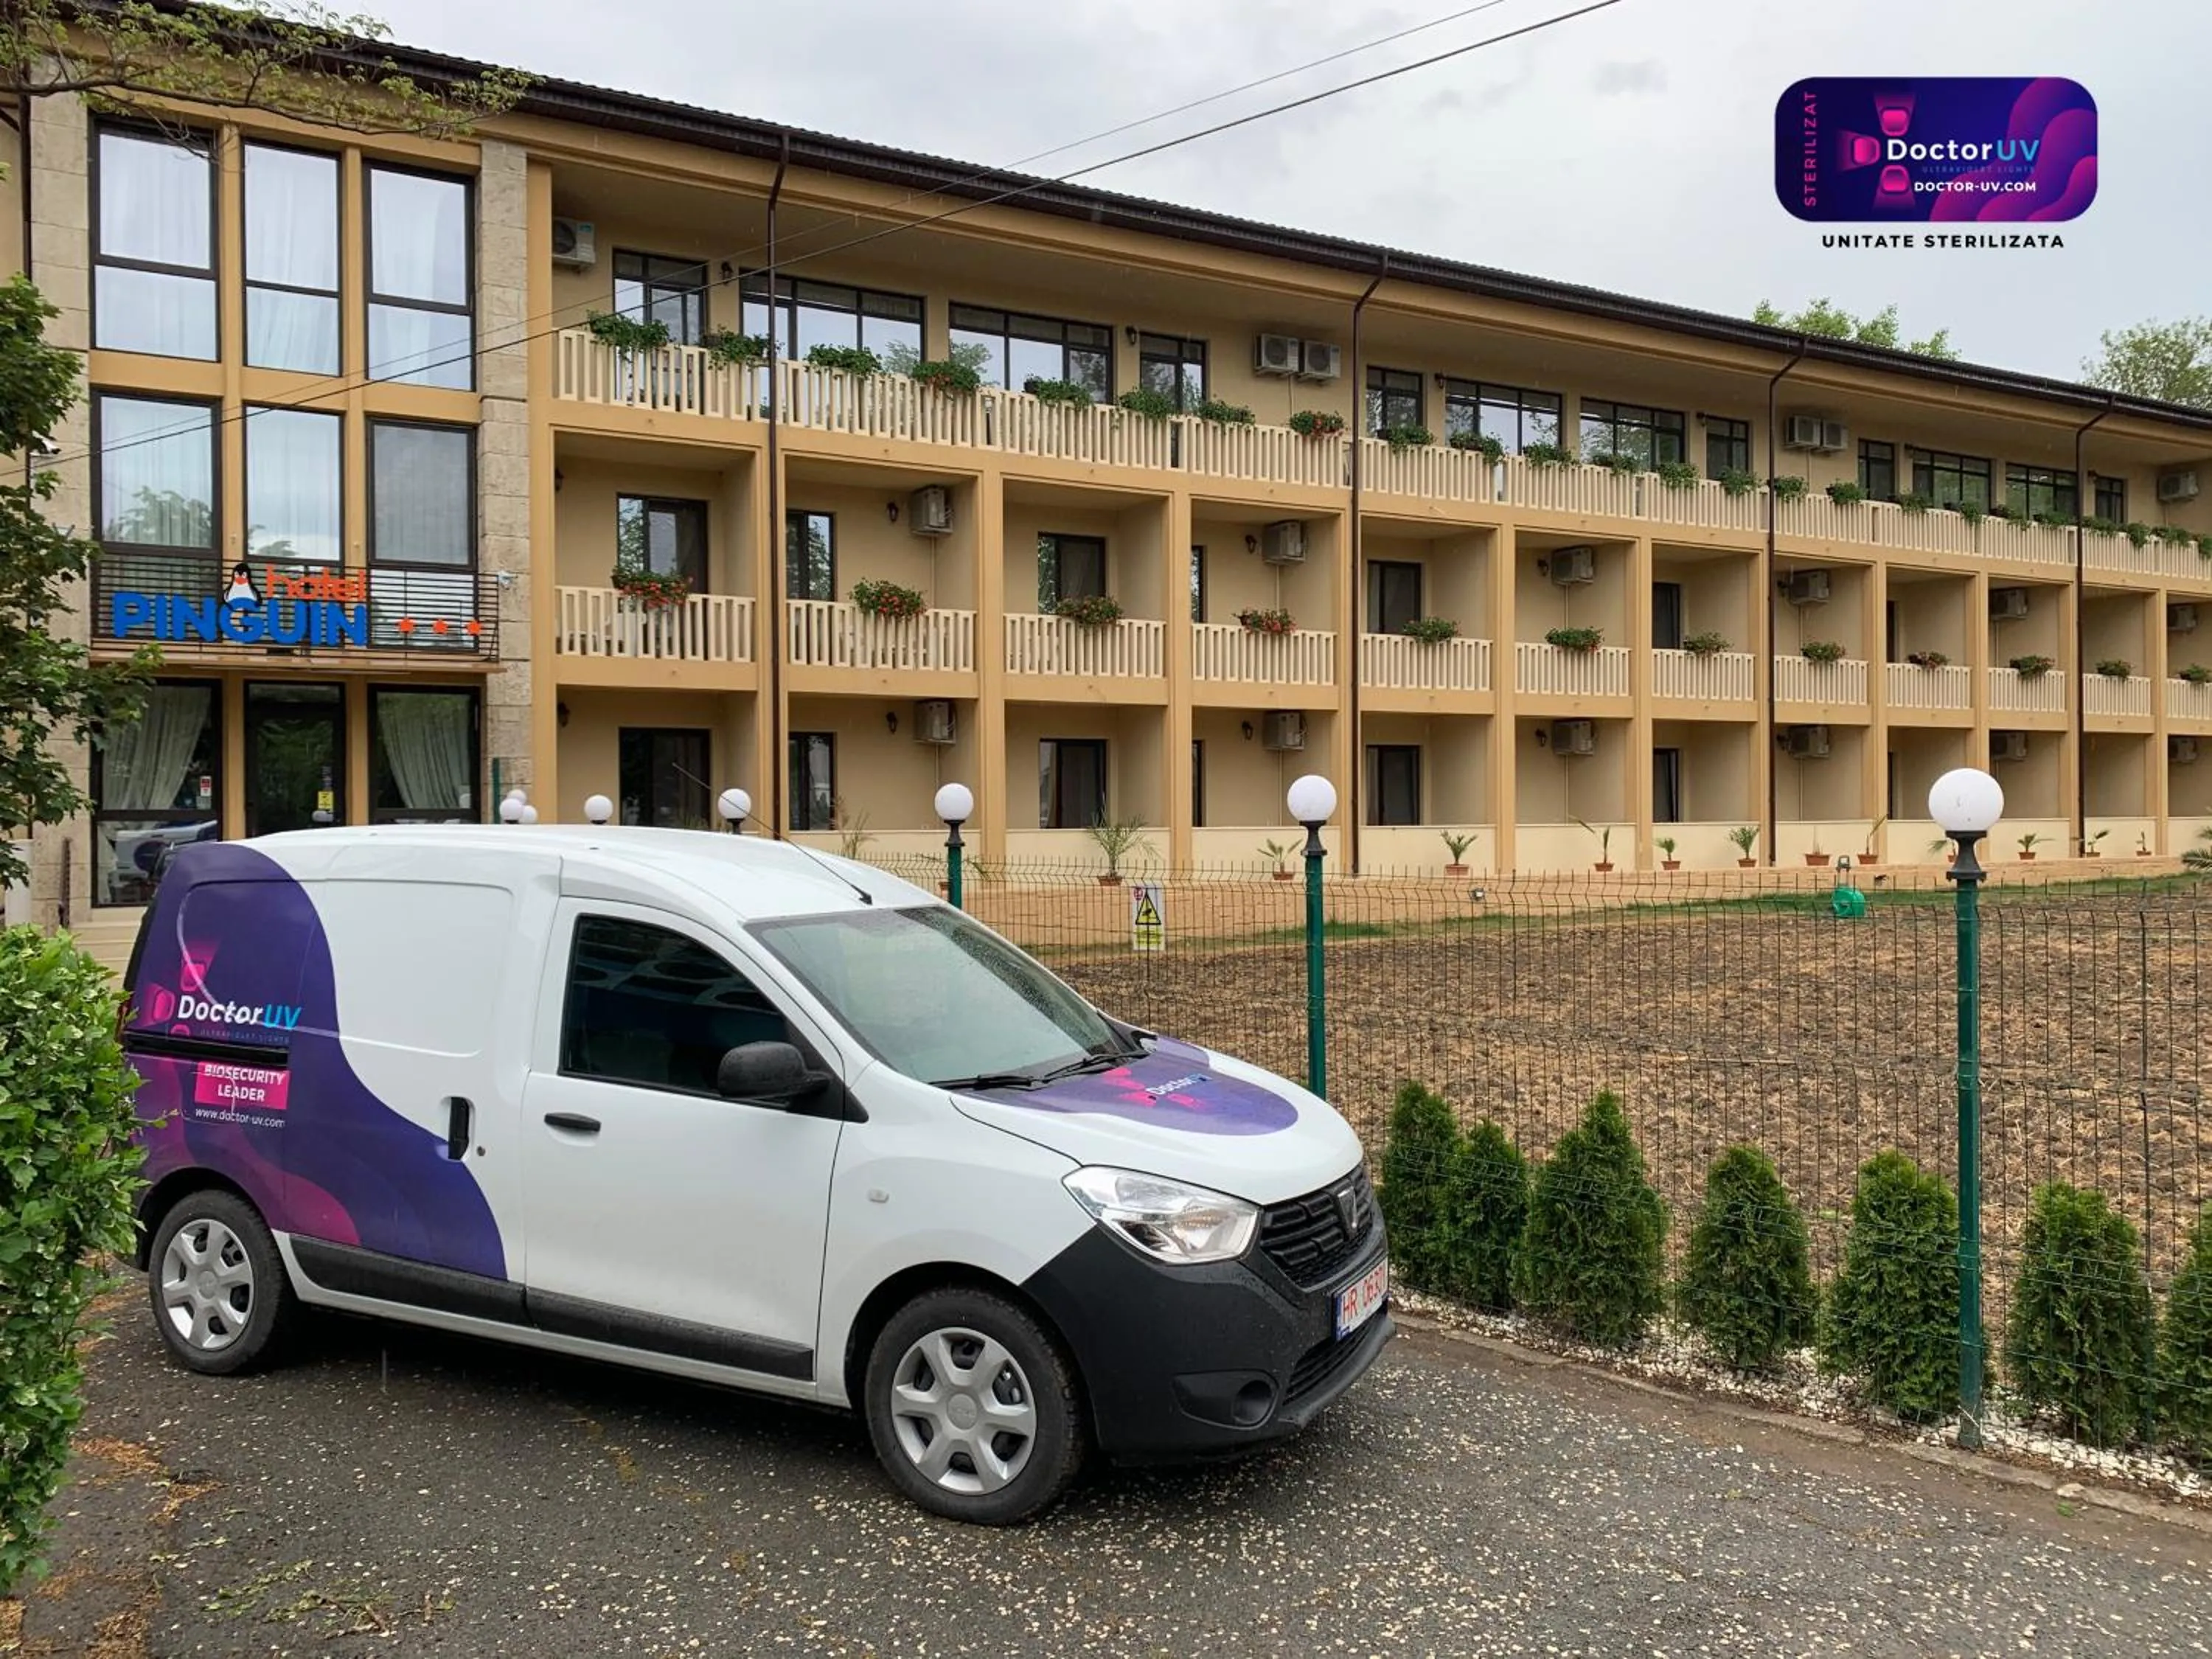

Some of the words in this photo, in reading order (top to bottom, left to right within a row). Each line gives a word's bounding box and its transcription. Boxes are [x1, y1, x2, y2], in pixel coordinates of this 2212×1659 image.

[266, 563, 366, 602] hotel
[113, 591, 367, 647] PINGUIN
[204, 1064, 286, 1086] BIOSECURITY
[218, 1084, 265, 1102] LEADER
[195, 1108, 285, 1128] www.doctor-uv.com
